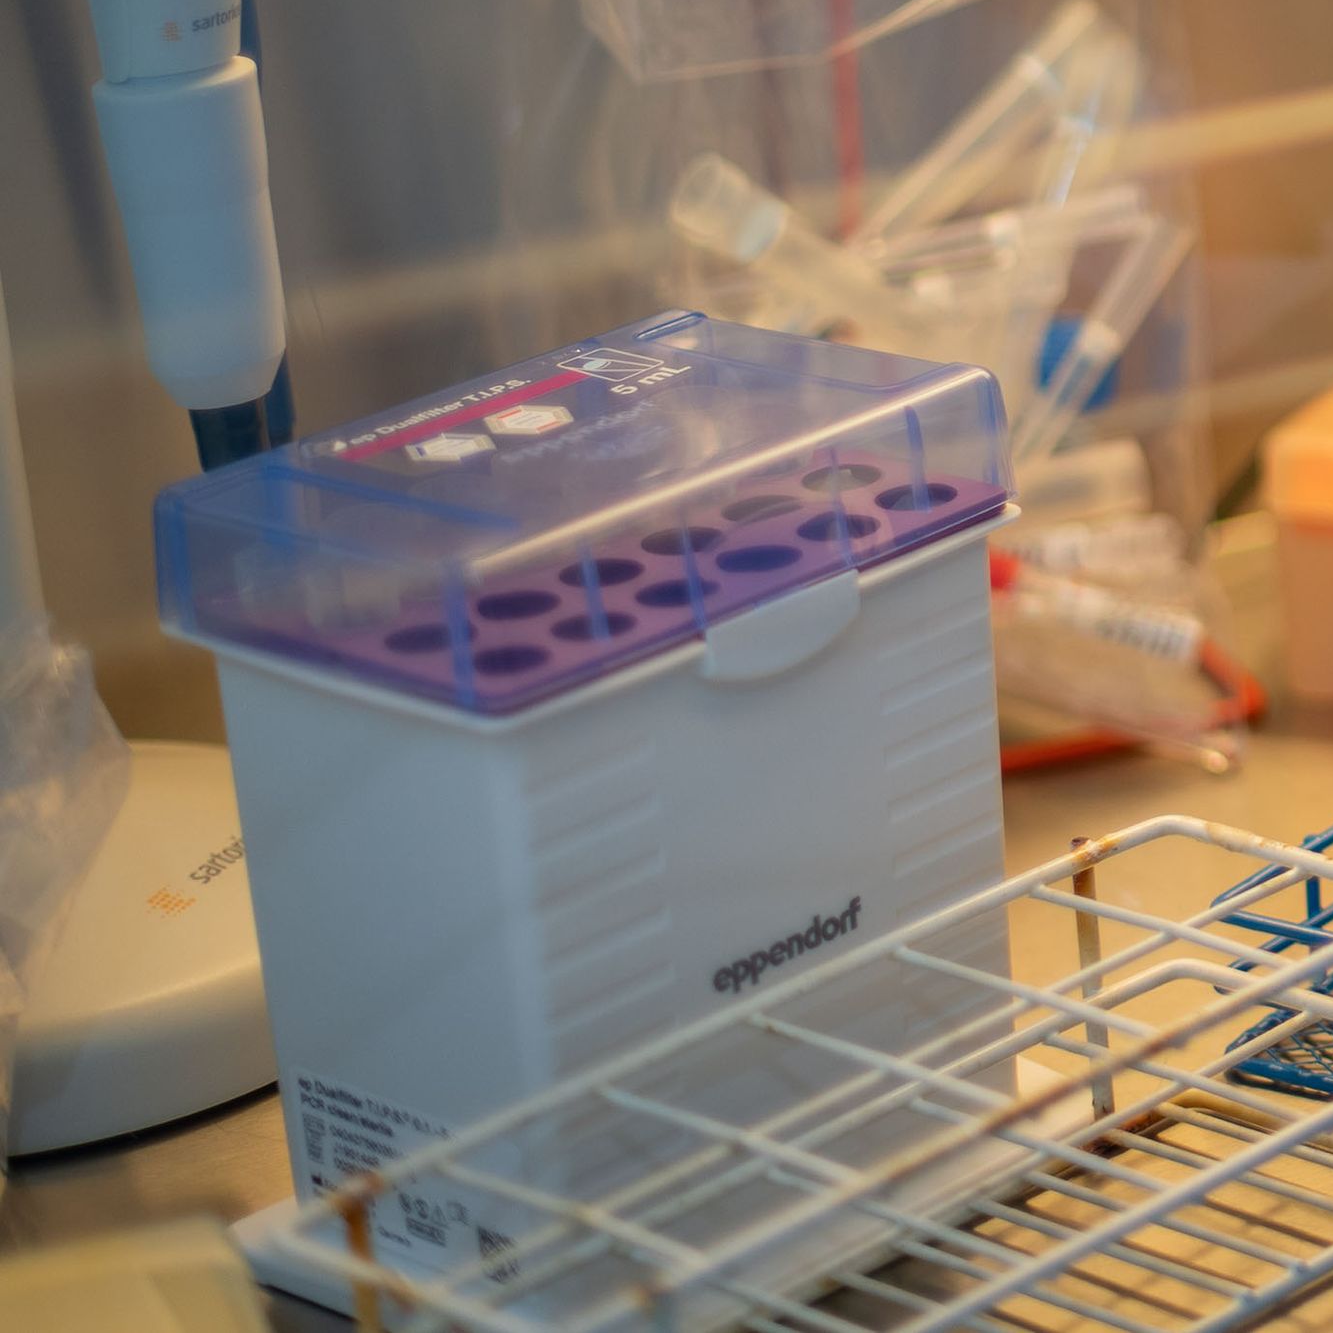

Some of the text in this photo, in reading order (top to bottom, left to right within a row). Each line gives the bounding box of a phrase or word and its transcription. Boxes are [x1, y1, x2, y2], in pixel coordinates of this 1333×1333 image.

[609, 365, 692, 395] 5 mL
[713, 895, 862, 993] eppendorf
